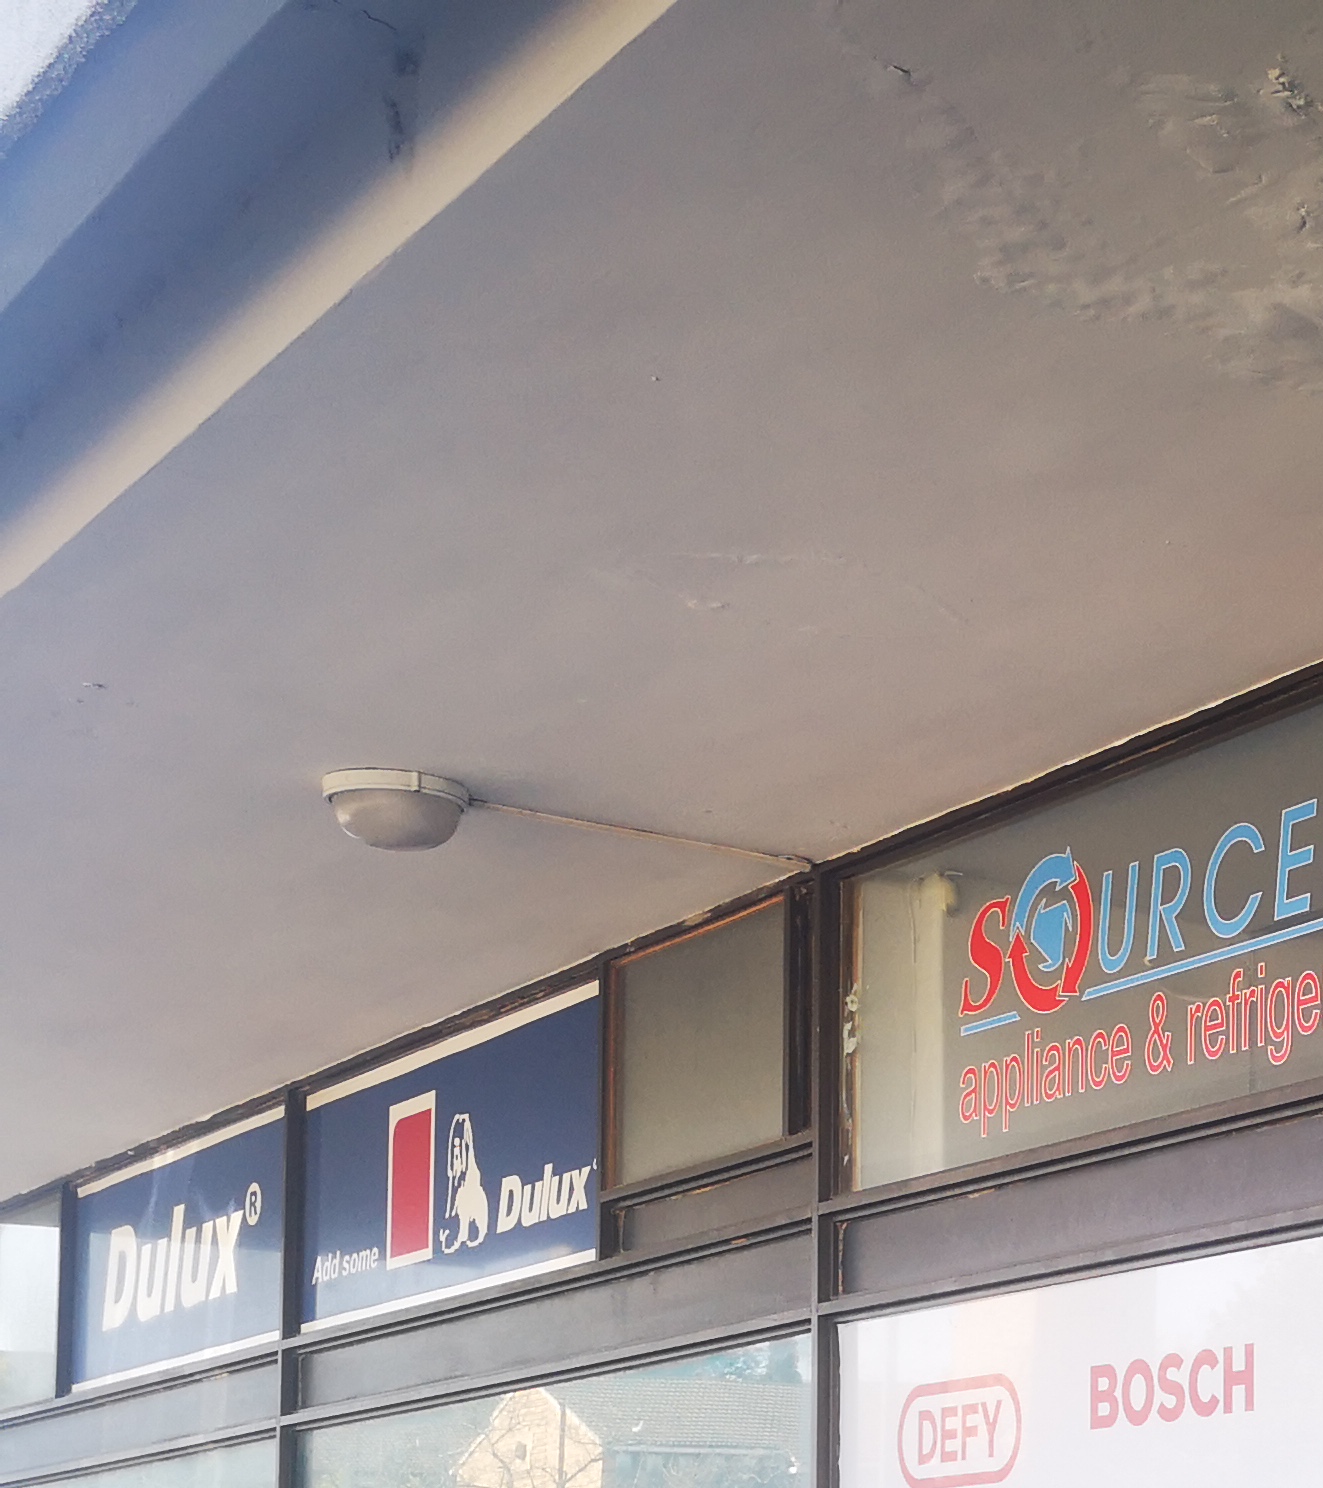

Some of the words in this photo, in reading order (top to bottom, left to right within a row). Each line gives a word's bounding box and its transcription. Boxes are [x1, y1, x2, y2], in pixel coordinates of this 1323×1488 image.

[959, 1022, 1132, 1137] appliance
[1146, 992, 1173, 1075] &
[312, 1251, 341, 1285] Add
[342, 1246, 379, 1277] some
[1089, 1342, 1256, 1431] BOSCH
[917, 1399, 1003, 1467] DEFY
